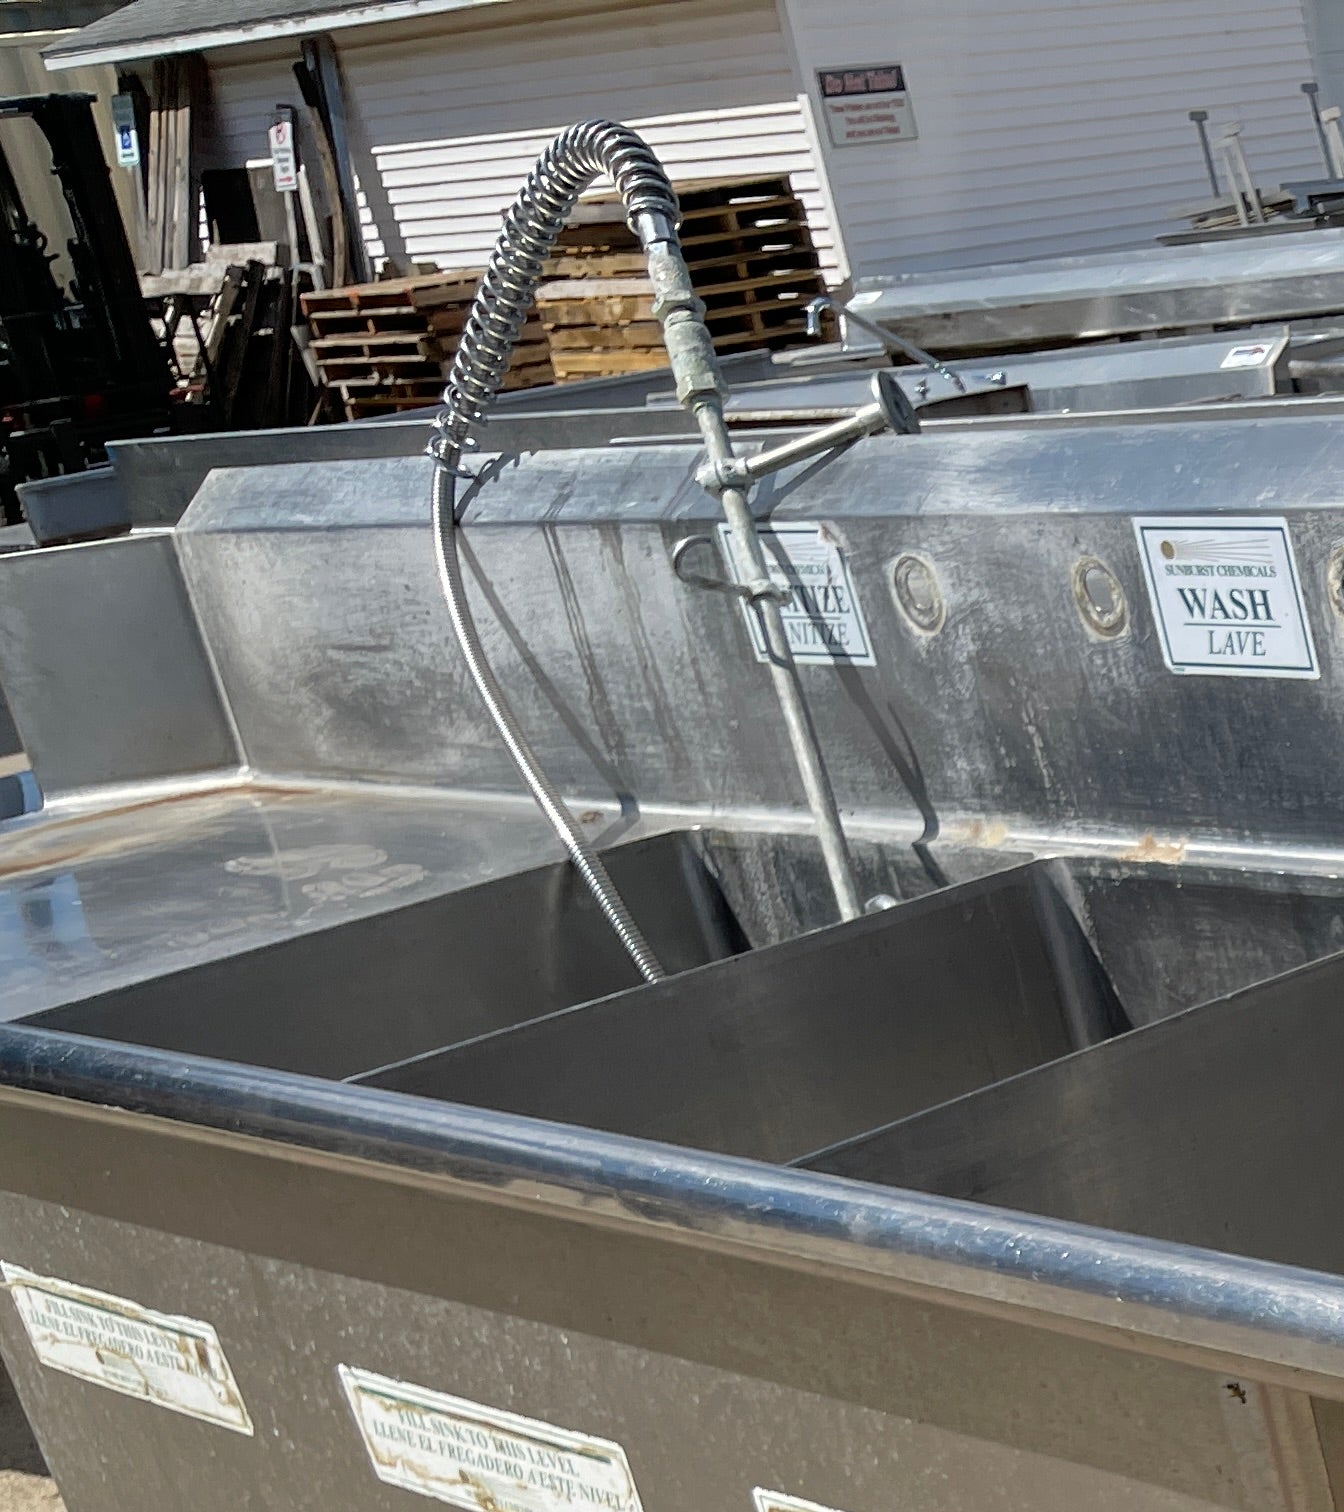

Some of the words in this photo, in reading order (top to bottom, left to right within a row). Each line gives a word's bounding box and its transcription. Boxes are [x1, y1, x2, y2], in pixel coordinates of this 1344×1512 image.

[1165, 564, 1215, 577] SUNBURST
[1216, 565, 1277, 578] CHEMICALS
[1176, 587, 1275, 621] WASH
[1207, 629, 1267, 657] LAVE
[29, 1309, 63, 1333] LLENE
[63, 1320, 79, 1338] EL
[70, 1306, 98, 1329] SINK
[97, 1313, 115, 1334] TO
[116, 1319, 142, 1343] THIS
[398, 1409, 432, 1432] FILL
[430, 1417, 468, 1443] SINK
[465, 1428, 489, 1450] TO
[492, 1436, 526, 1460] THIS
[527, 1447, 580, 1478] LEVEL
[373, 1419, 417, 1448] LLENE
[418, 1433, 437, 1453] EL
[439, 1439, 524, 1480] FREGADERO
[528, 1468, 536, 1485] A
[539, 1471, 574, 1497] ESTE
[579, 1482, 625, 1512] NIVEL
